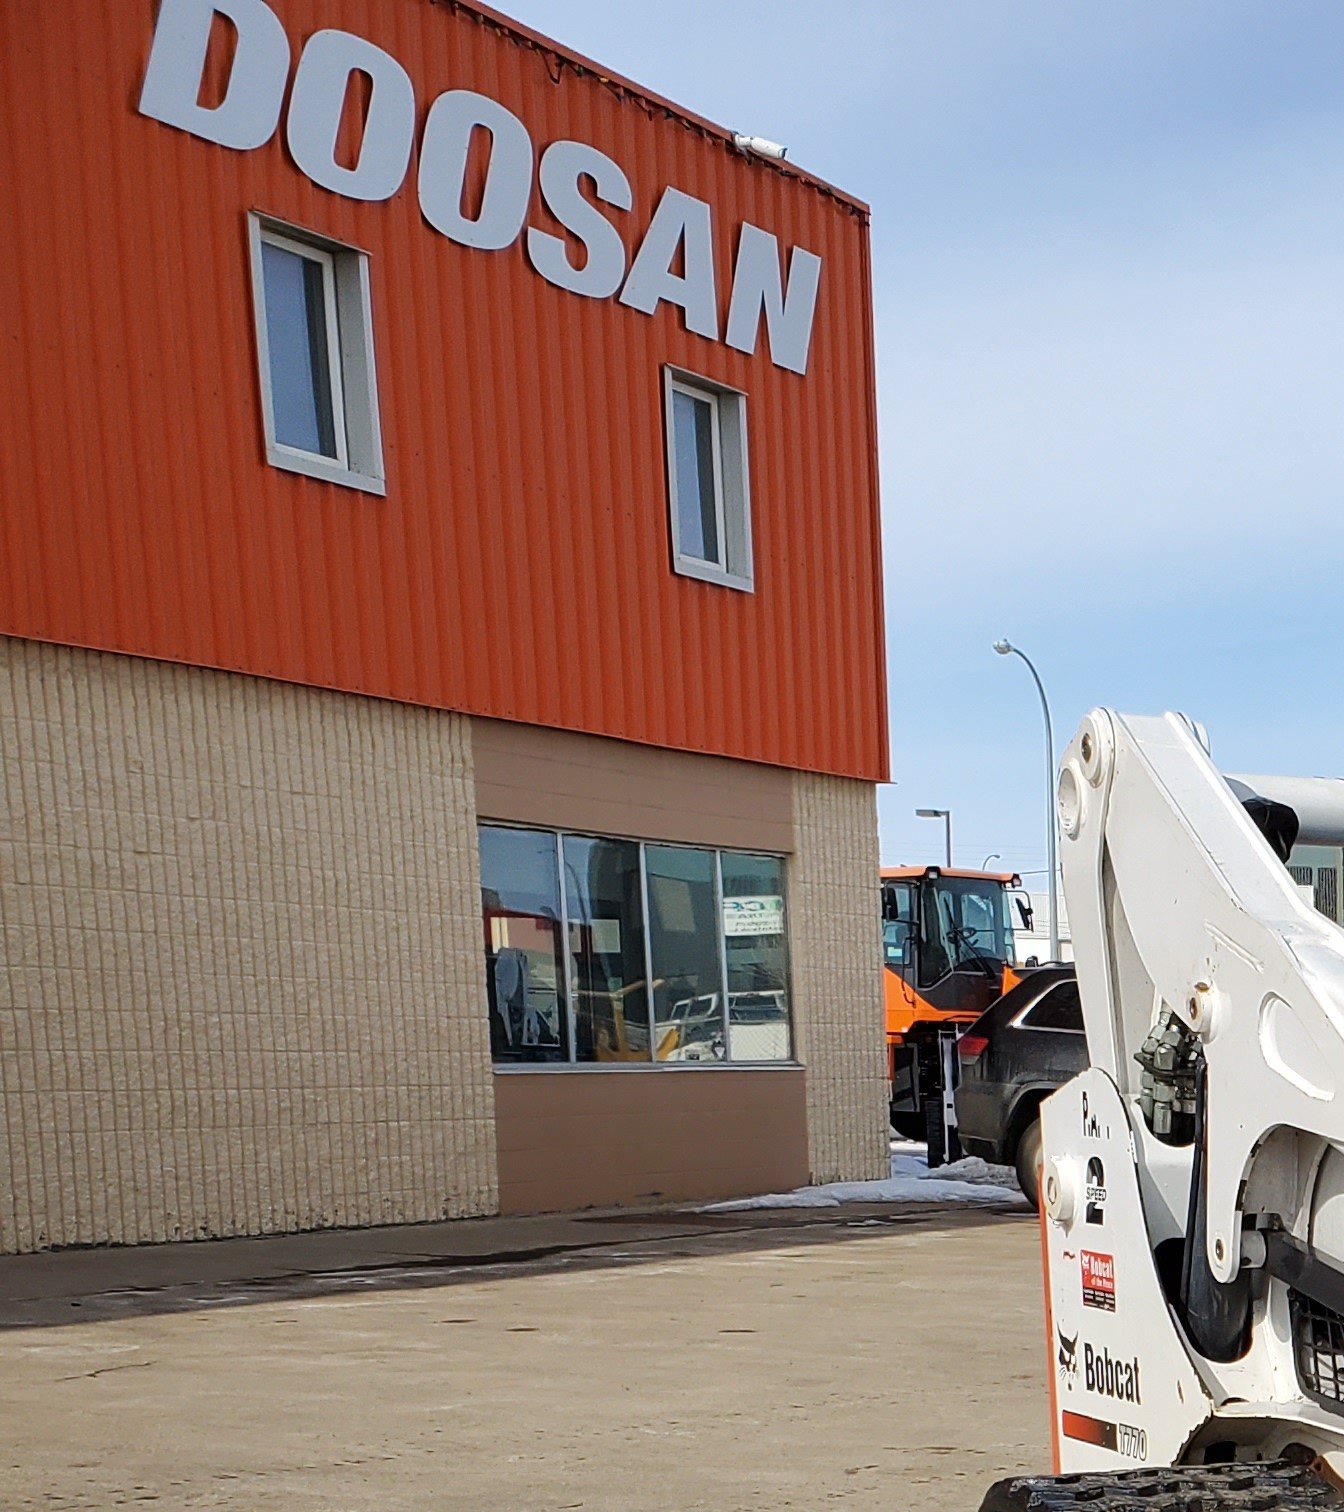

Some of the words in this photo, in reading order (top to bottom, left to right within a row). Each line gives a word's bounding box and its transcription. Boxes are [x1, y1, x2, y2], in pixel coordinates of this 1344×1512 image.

[138, 0, 822, 376] DOOSAN
[1085, 1186, 1107, 1202] SPEED
[1084, 1342, 1142, 1406] Bobcat
[1119, 1422, 1148, 1462] T770
